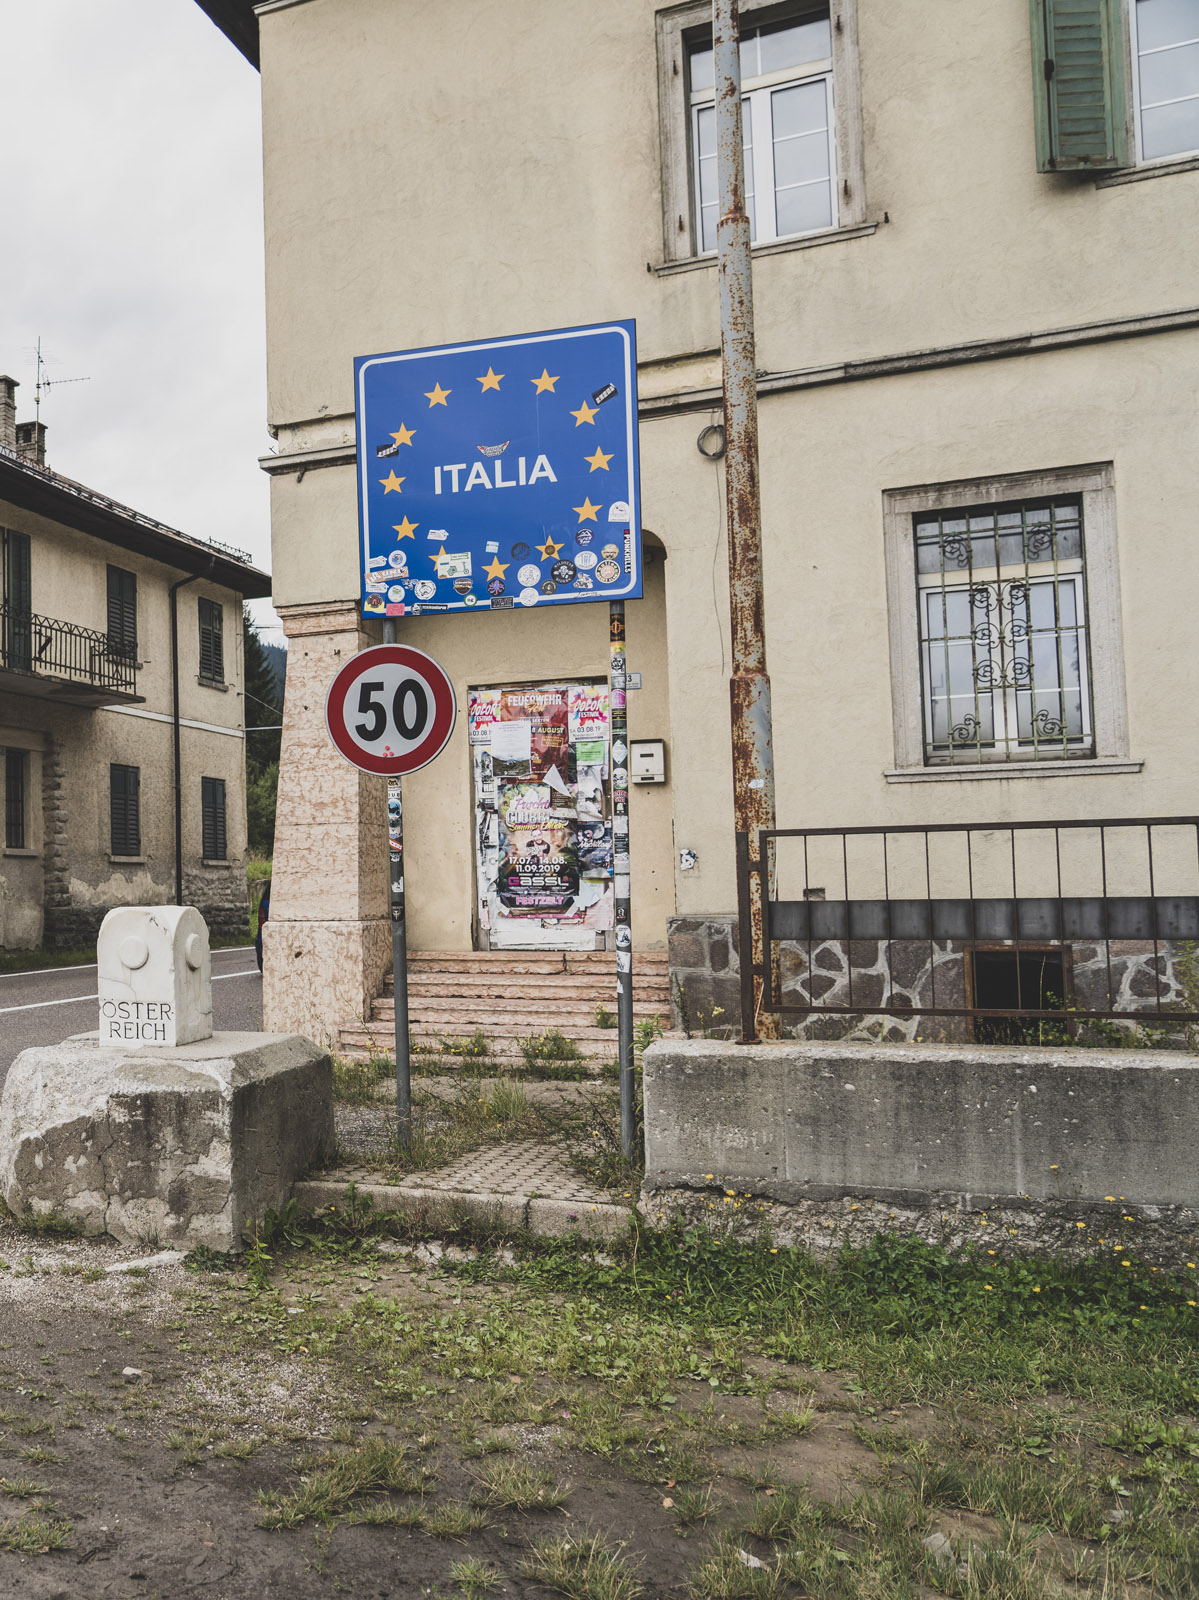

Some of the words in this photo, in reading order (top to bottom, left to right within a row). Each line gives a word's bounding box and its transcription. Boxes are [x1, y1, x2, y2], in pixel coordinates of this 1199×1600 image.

[434, 454, 558, 495] ITALIA
[508, 694, 562, 707] FEUERWEHR
[574, 698, 603, 712] COLOR
[355, 679, 428, 741] 50
[470, 702, 496, 716] COLOR
[509, 856, 533, 864] 17.07.
[540, 856, 567, 864] 14.08.
[516, 865, 560, 873] 11.09.2019
[109, 1021, 166, 1041] REICH
